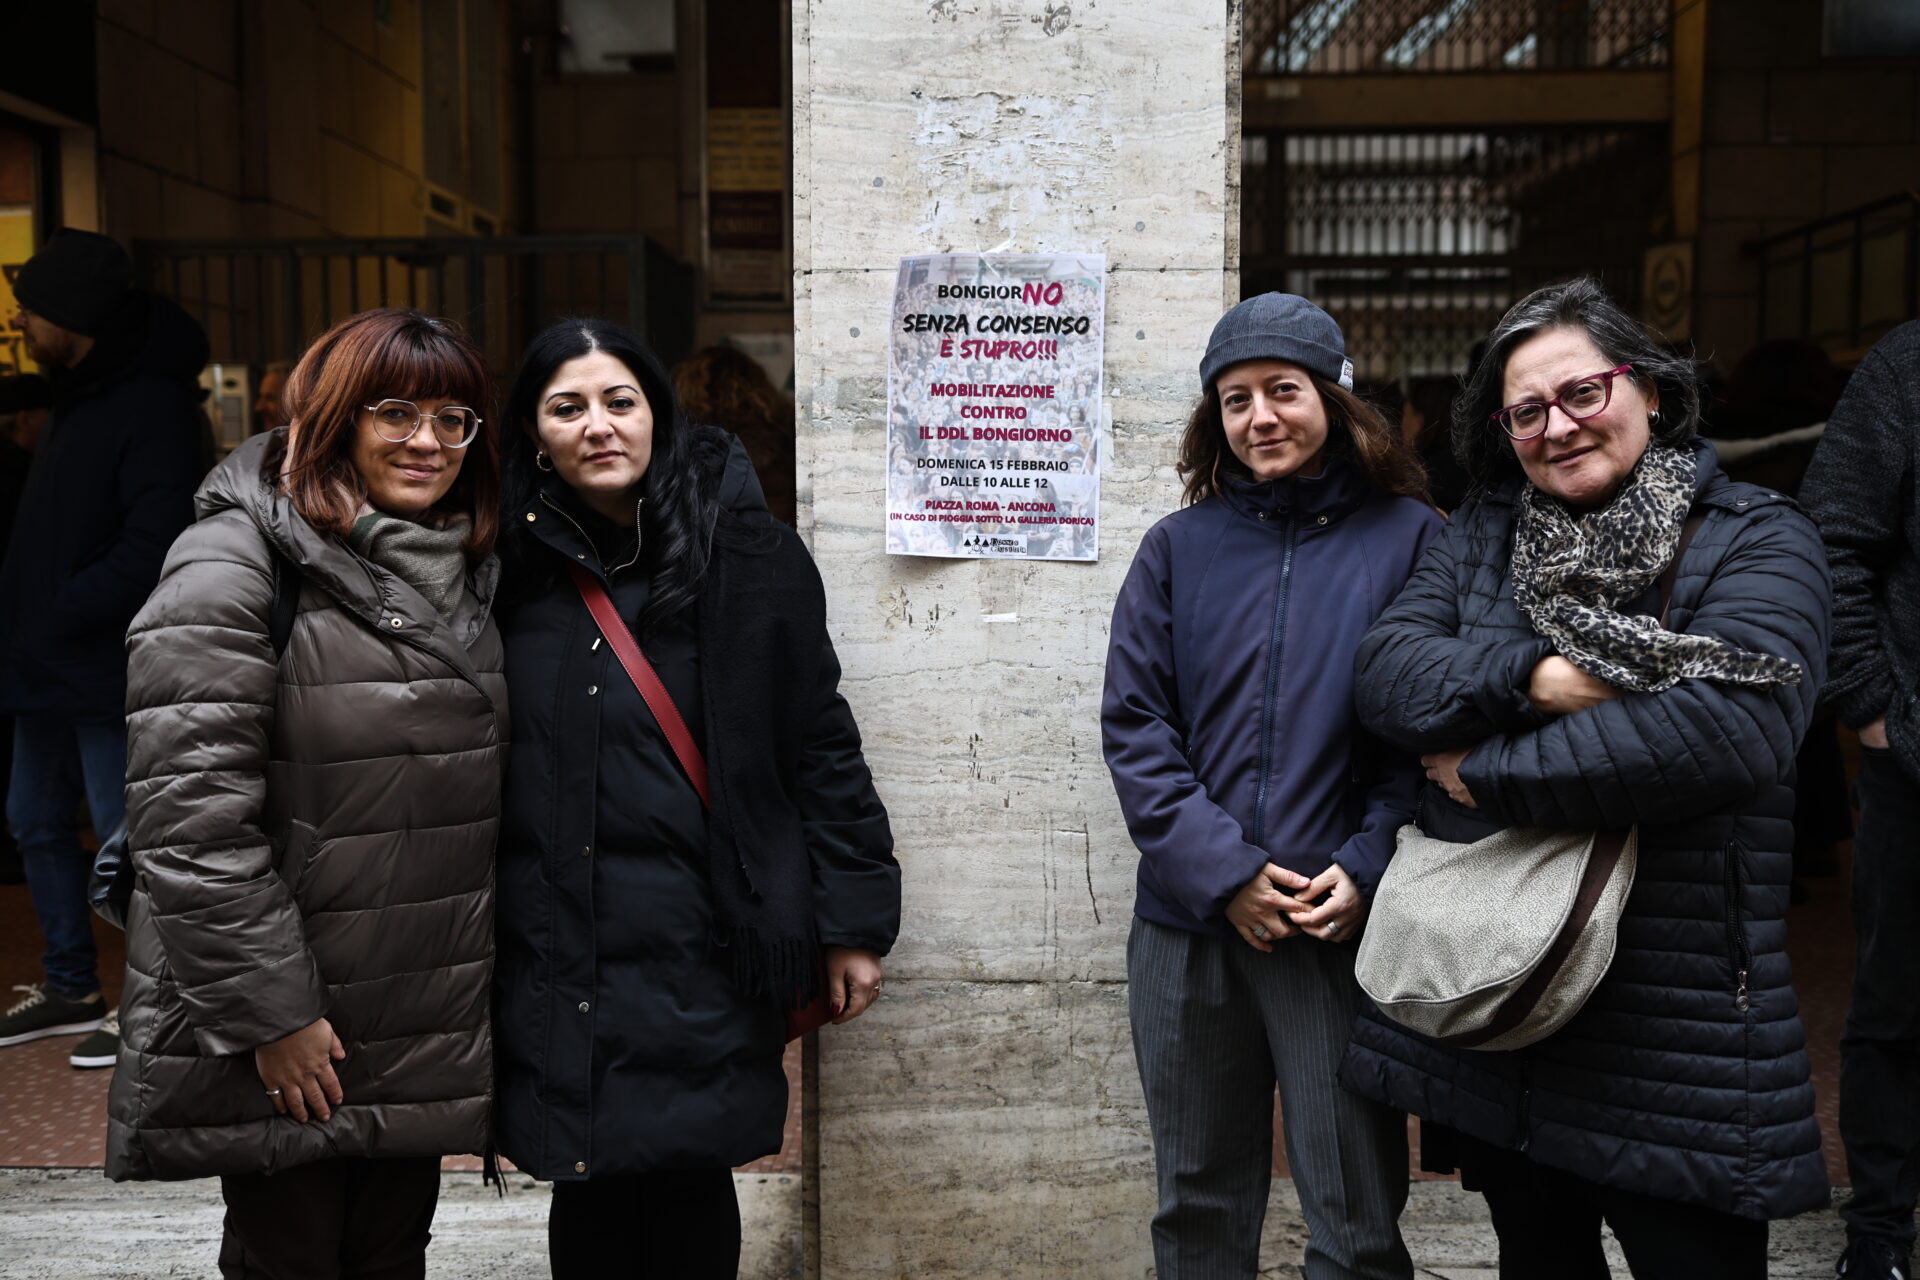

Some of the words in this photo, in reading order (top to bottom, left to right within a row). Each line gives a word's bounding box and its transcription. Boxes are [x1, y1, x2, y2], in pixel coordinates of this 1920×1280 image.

[938, 282, 1064, 306] BONGIORNO
[903, 314, 969, 334] SENZA
[977, 315, 1090, 335] CONSENSO
[940, 334, 953, 358] È
[960, 340, 1058, 360] STUPRO!!!
[931, 383, 1054, 398] MOBILITAZIONE
[961, 405, 1027, 420] CONTRO
[920, 426, 933, 440] IL
[937, 427, 969, 440] DDL
[973, 428, 1072, 442] BONGIORNO
[917, 458, 986, 470] DOMENICA
[990, 460, 1003, 470] 15
[1007, 460, 1069, 471] FEBBRAIO
[941, 476, 979, 487] DALLE
[983, 477, 997, 487] 10
[1000, 478, 1030, 488] ALLE
[1034, 478, 1048, 488] 12
[925, 500, 963, 510] PIAZZA
[966, 501, 999, 511] ROMA
[1008, 502, 1056, 512] ANCONA
[904, 513, 926, 521] CASO
[939, 515, 974, 523] PIOGGIA
[975, 515, 1003, 523] SOTTO
[1005, 516, 1016, 524] LA
[1018, 516, 1057, 525] GALLERIA
[1059, 517, 1094, 526] DORICA)
